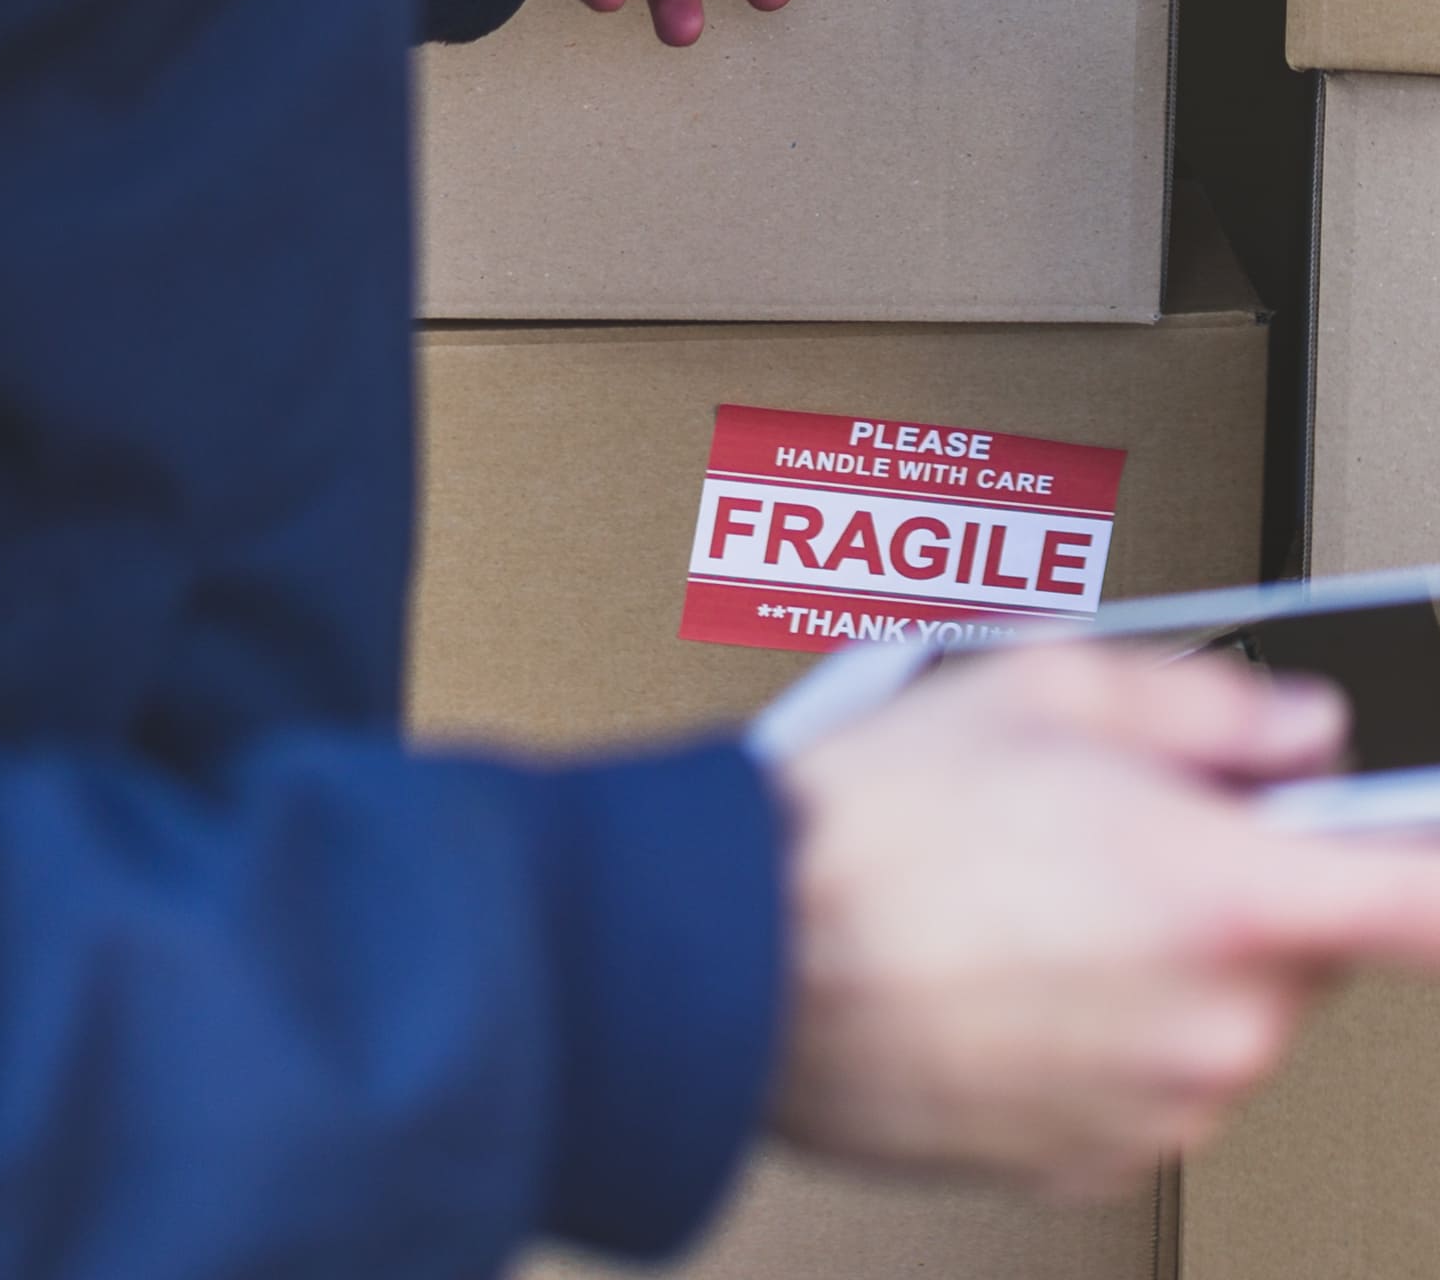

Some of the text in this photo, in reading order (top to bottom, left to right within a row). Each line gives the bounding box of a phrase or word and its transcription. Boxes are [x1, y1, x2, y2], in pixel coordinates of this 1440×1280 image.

[849, 421, 993, 461] PLEASE
[775, 447, 1055, 496] HANDLE WITH CARE
[707, 495, 1094, 597] FRAGILE
